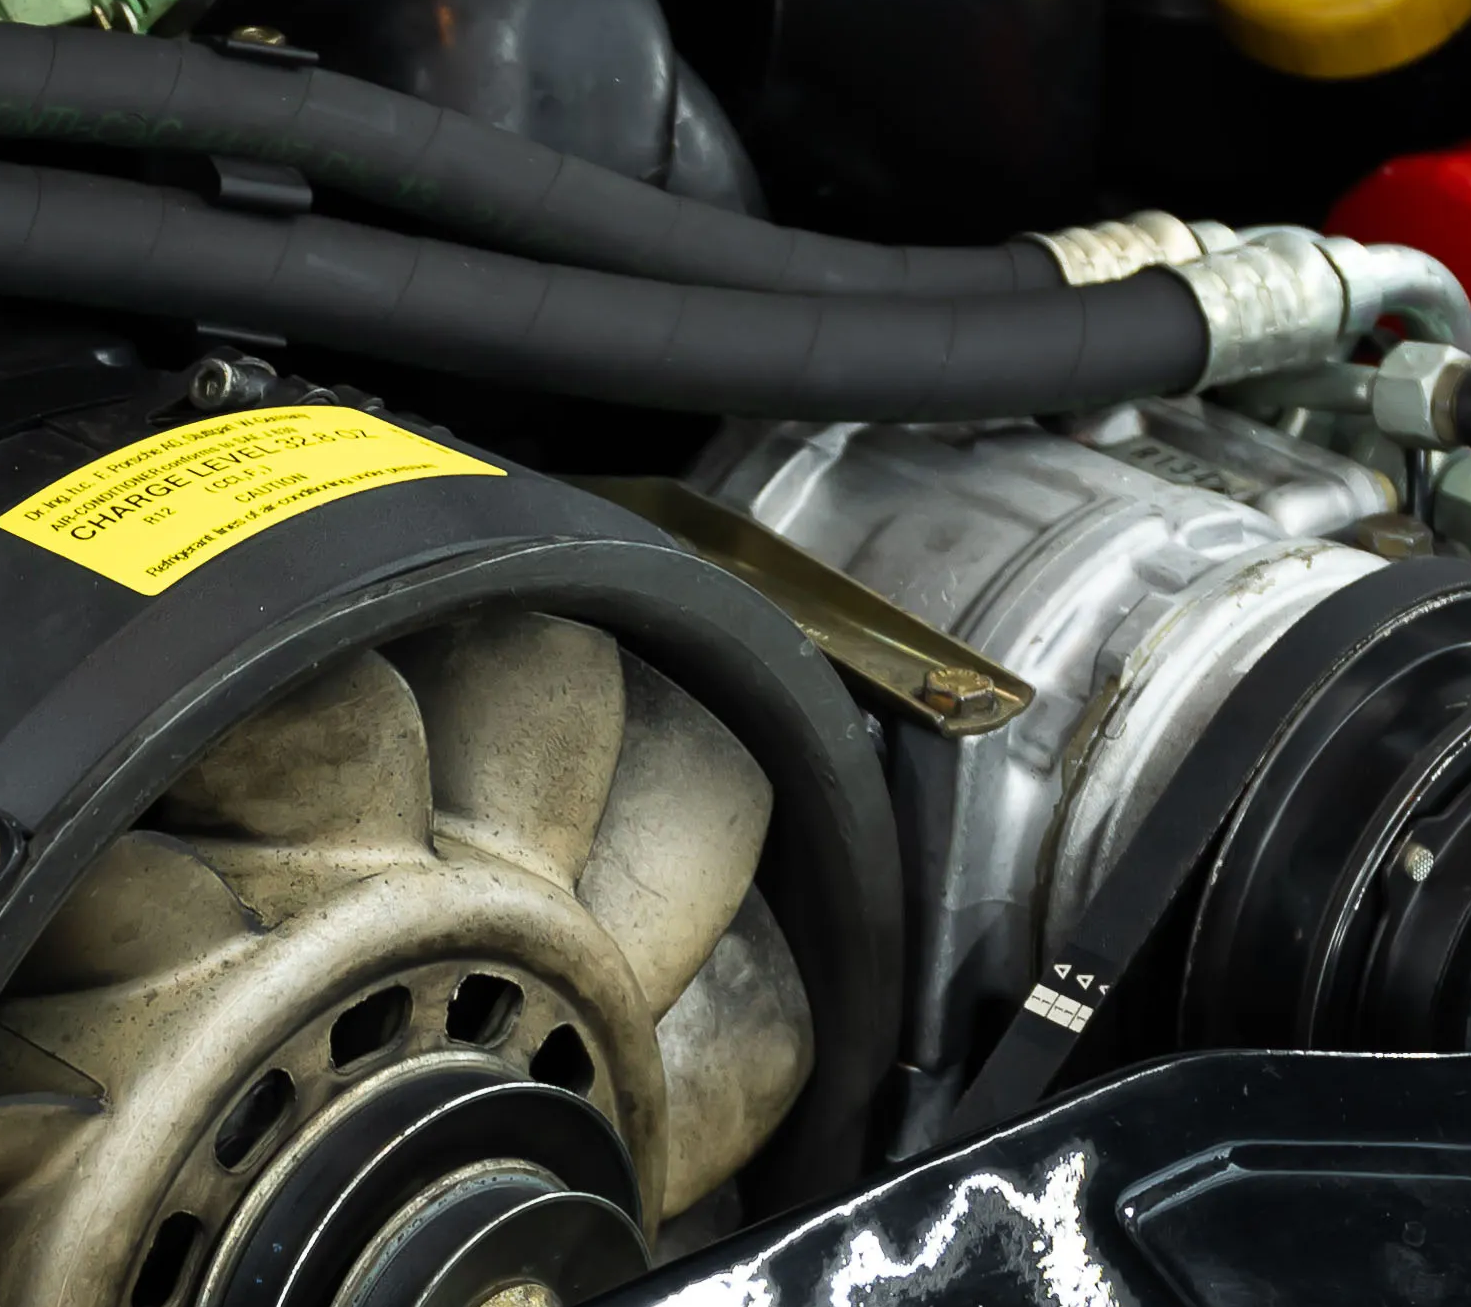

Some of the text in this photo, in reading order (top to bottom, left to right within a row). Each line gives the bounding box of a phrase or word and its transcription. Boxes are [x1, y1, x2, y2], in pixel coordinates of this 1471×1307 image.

[106, 447, 163, 474] Porsche
[50, 467, 164, 532] AIR-CONDITIONER
[70, 473, 192, 541] CHARGE
[186, 444, 282, 478] LEVEL
[234, 473, 309, 504] CAUTION
[142, 506, 176, 525] R12
